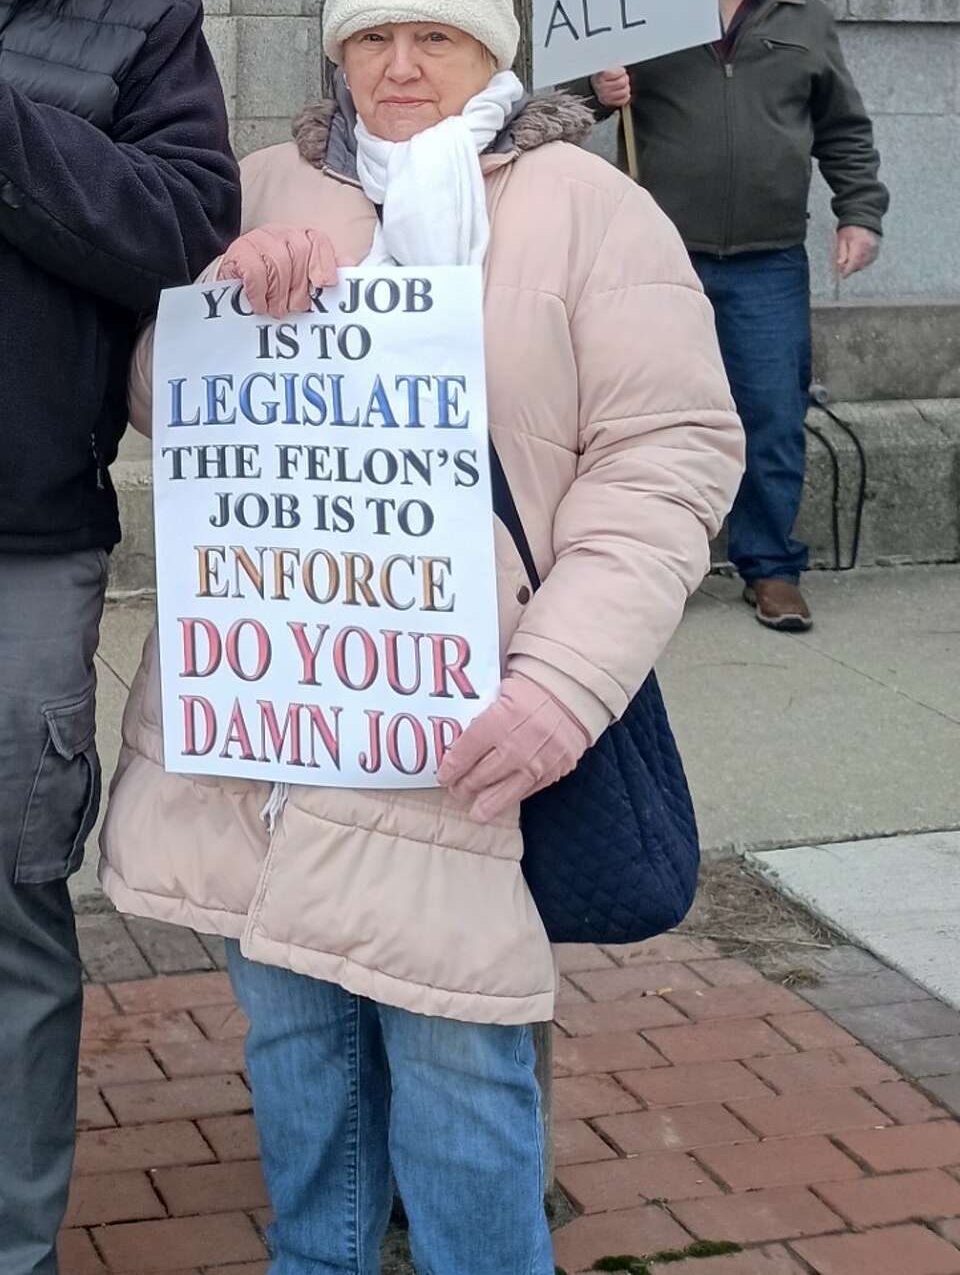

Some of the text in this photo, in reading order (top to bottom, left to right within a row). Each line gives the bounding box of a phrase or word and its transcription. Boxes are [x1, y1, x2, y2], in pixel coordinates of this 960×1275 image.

[340, 277, 434, 314] JOB
[256, 323, 372, 361] IS TO
[167, 372, 471, 430] LEGISLATE
[162, 444, 480, 488] THE FELON'S
[209, 492, 435, 537] JOB IS TO
[194, 545, 456, 613] ENFORCE
[177, 617, 480, 700] DO YOUR
[180, 695, 344, 772] DAMN
